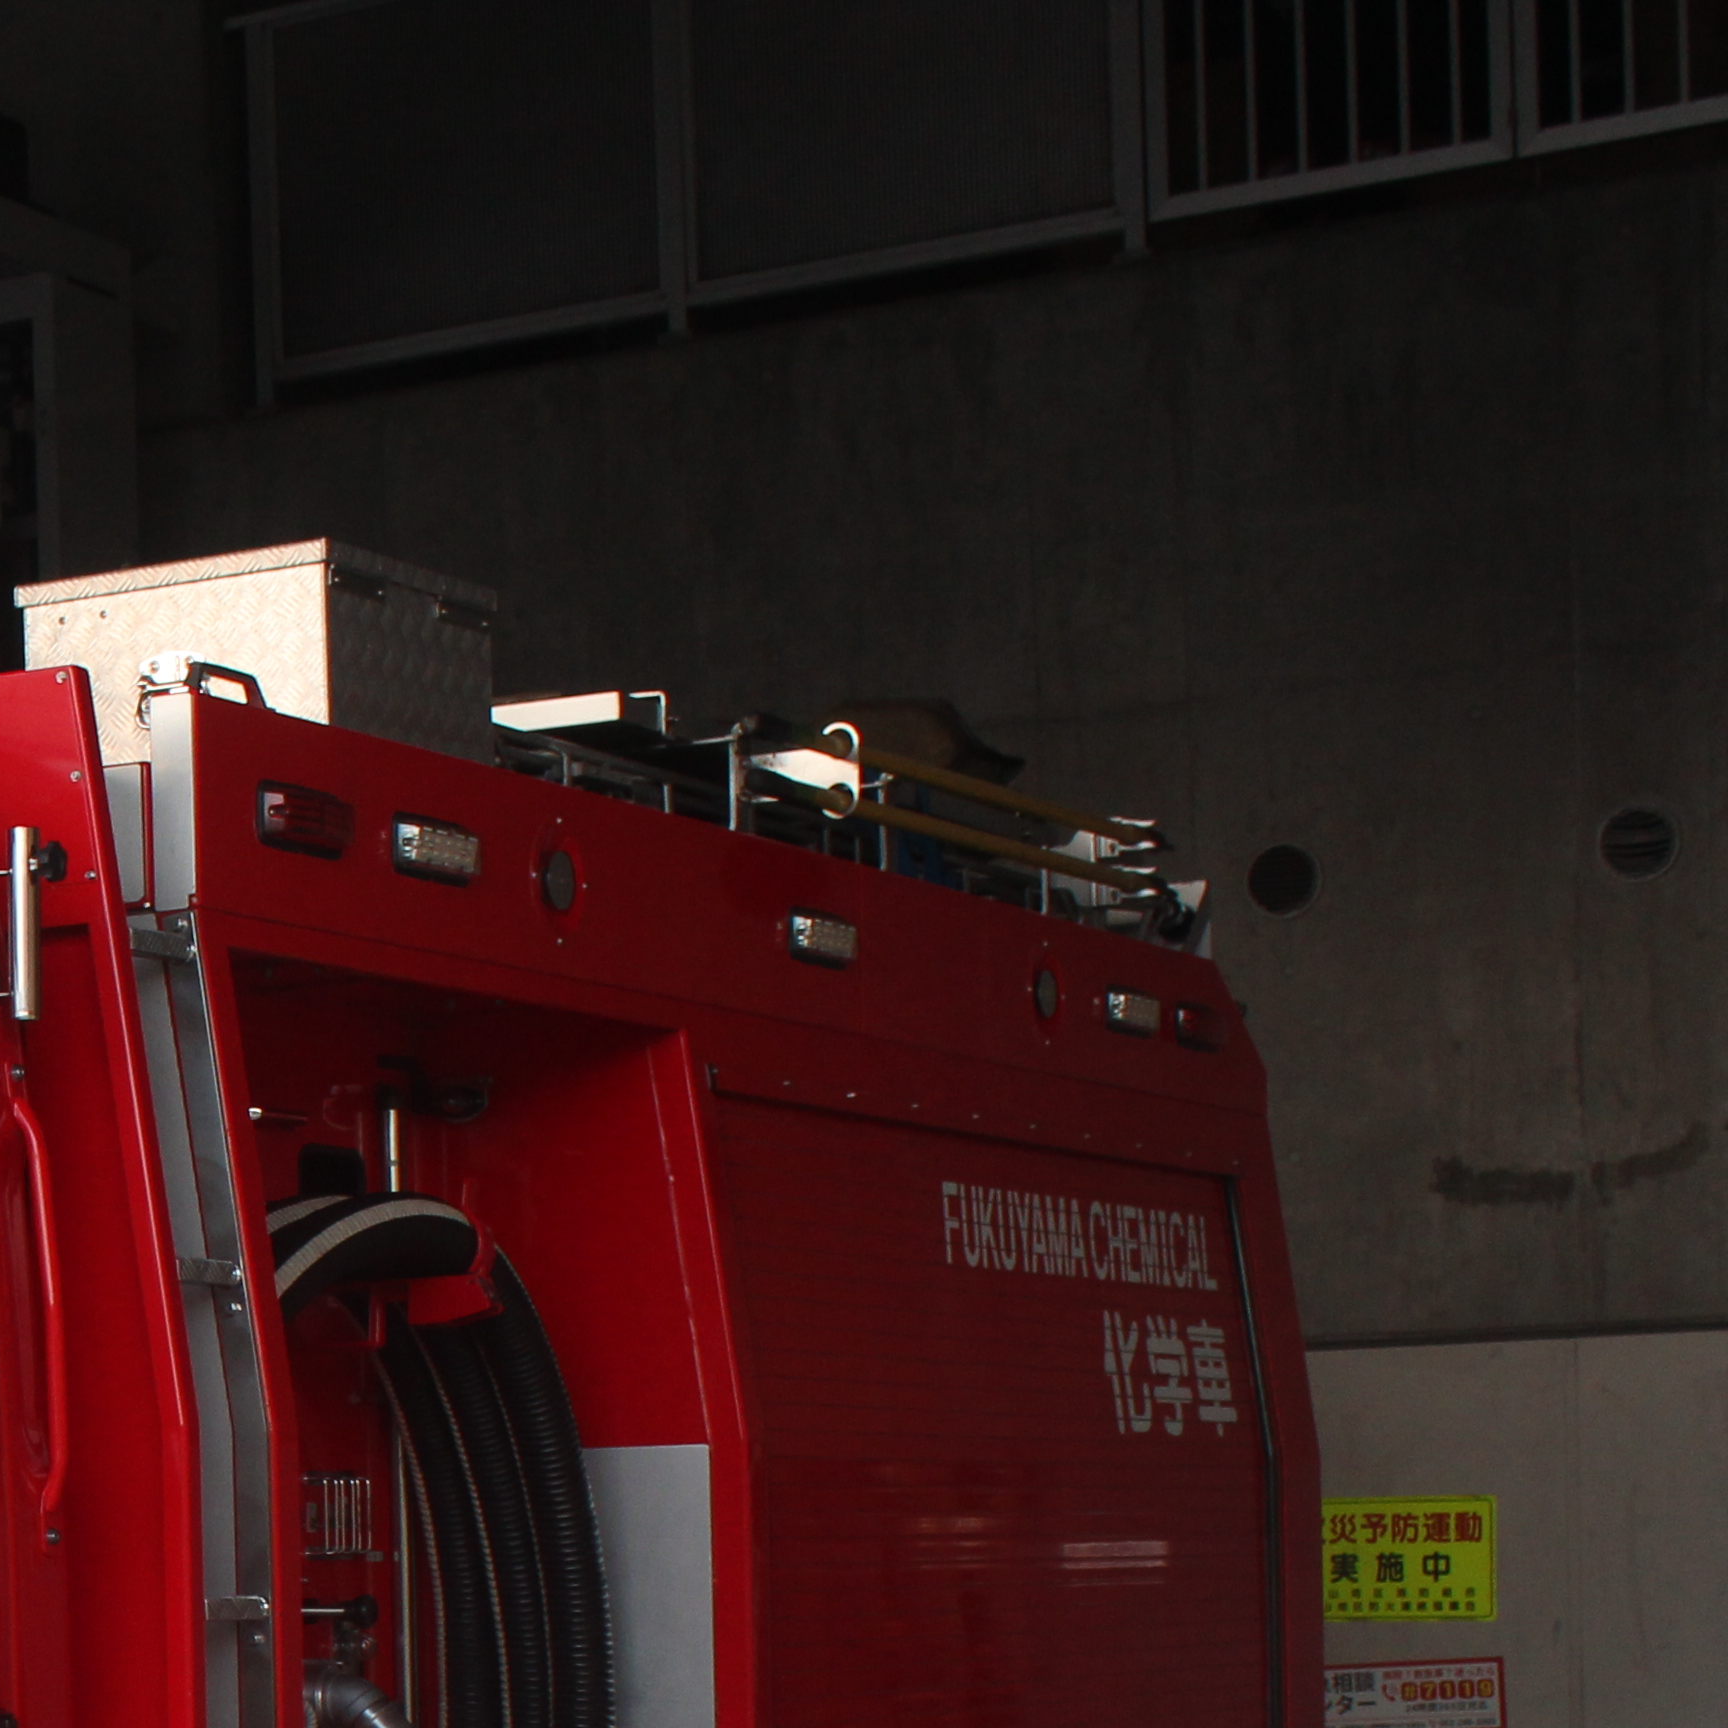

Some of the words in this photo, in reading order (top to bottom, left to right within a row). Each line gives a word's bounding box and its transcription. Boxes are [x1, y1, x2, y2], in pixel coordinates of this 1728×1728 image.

[942, 1181, 1089, 1278] FUKUYAMA
[1089, 1201, 1218, 1291] CHEMICAL
[1103, 1310, 1238, 1437] 化学車
[1322, 1512, 1482, 1544] 災予防運動
[1325, 1671, 1375, 1695] 相談
[1401, 1679, 1494, 1701] #7119
